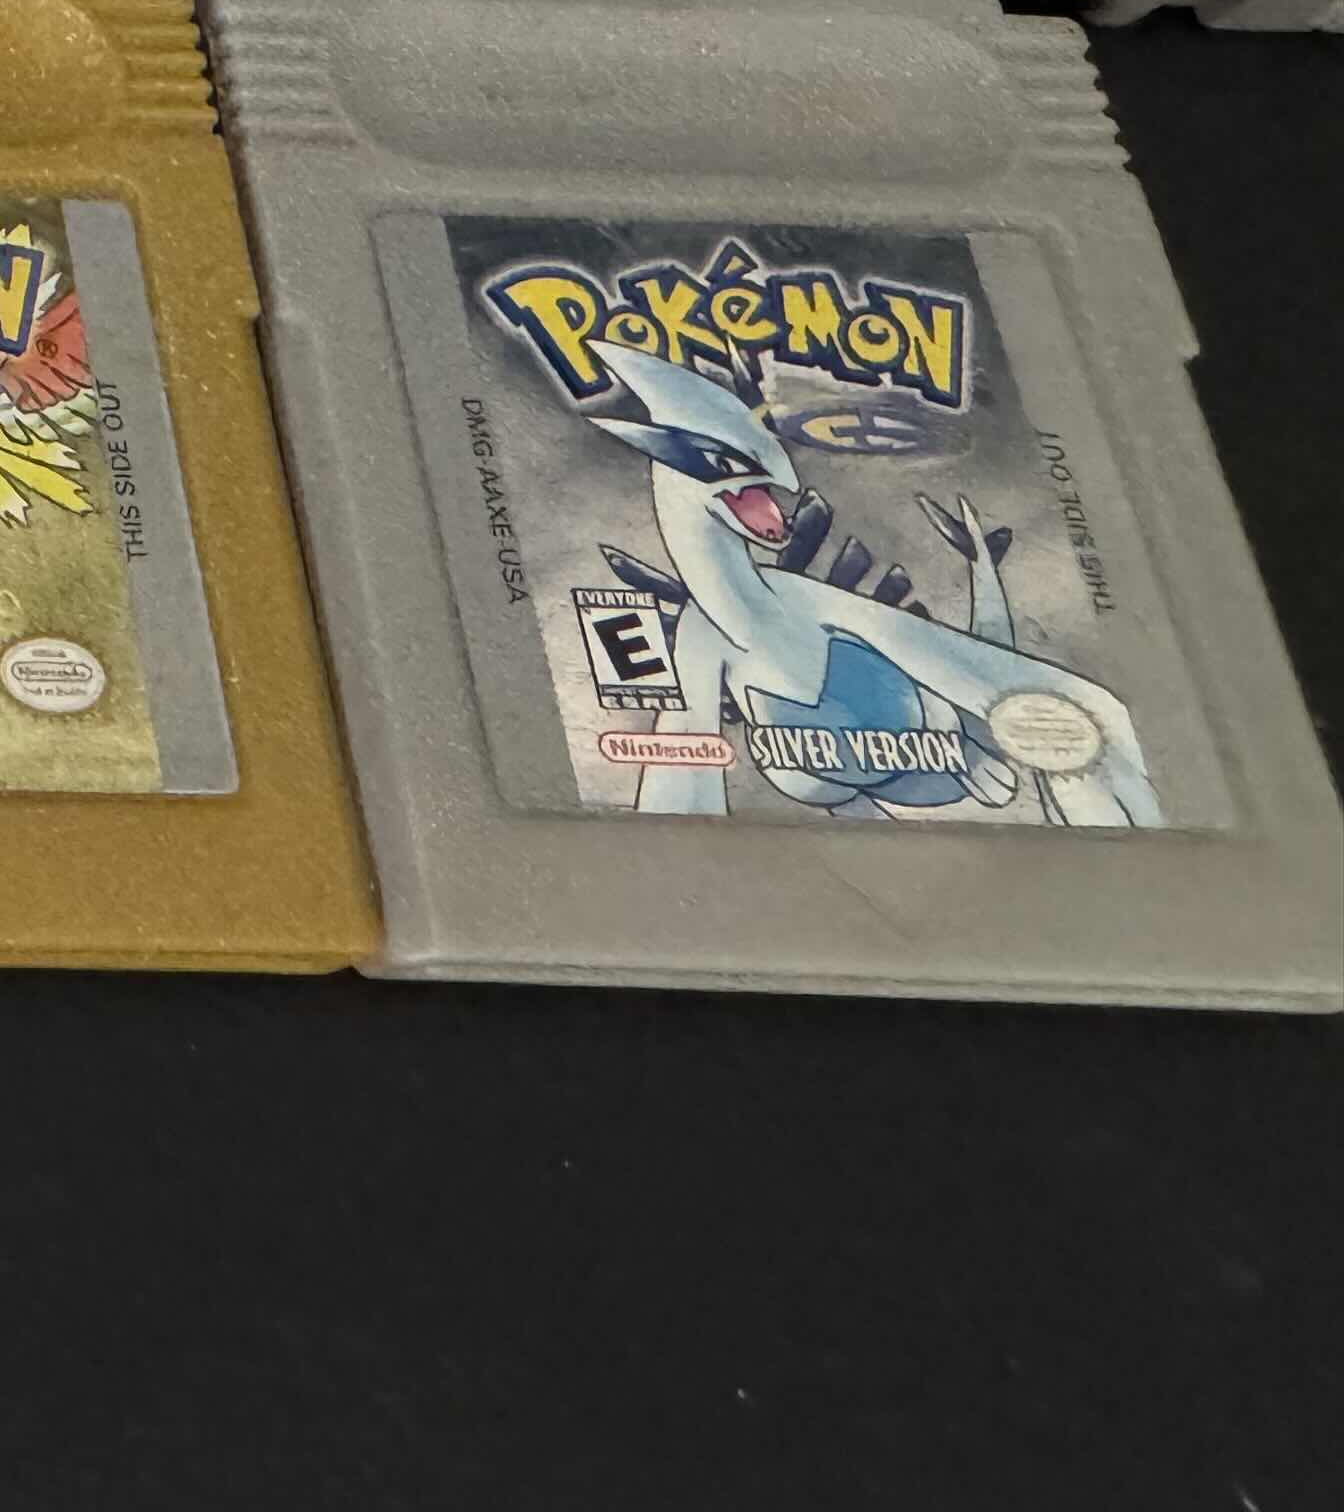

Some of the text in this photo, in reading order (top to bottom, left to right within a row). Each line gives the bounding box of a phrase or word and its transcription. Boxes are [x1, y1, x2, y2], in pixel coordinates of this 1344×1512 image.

[96, 375, 149, 563] THIS SIDE OUT
[1032, 426, 1073, 483] OUT
[576, 589, 657, 607] EVERYONE
[1079, 553, 1117, 616] THIS
[592, 612, 668, 682] E
[609, 738, 728, 760] Nintendo
[749, 722, 844, 773] SILVER
[846, 725, 970, 775] VERSION
